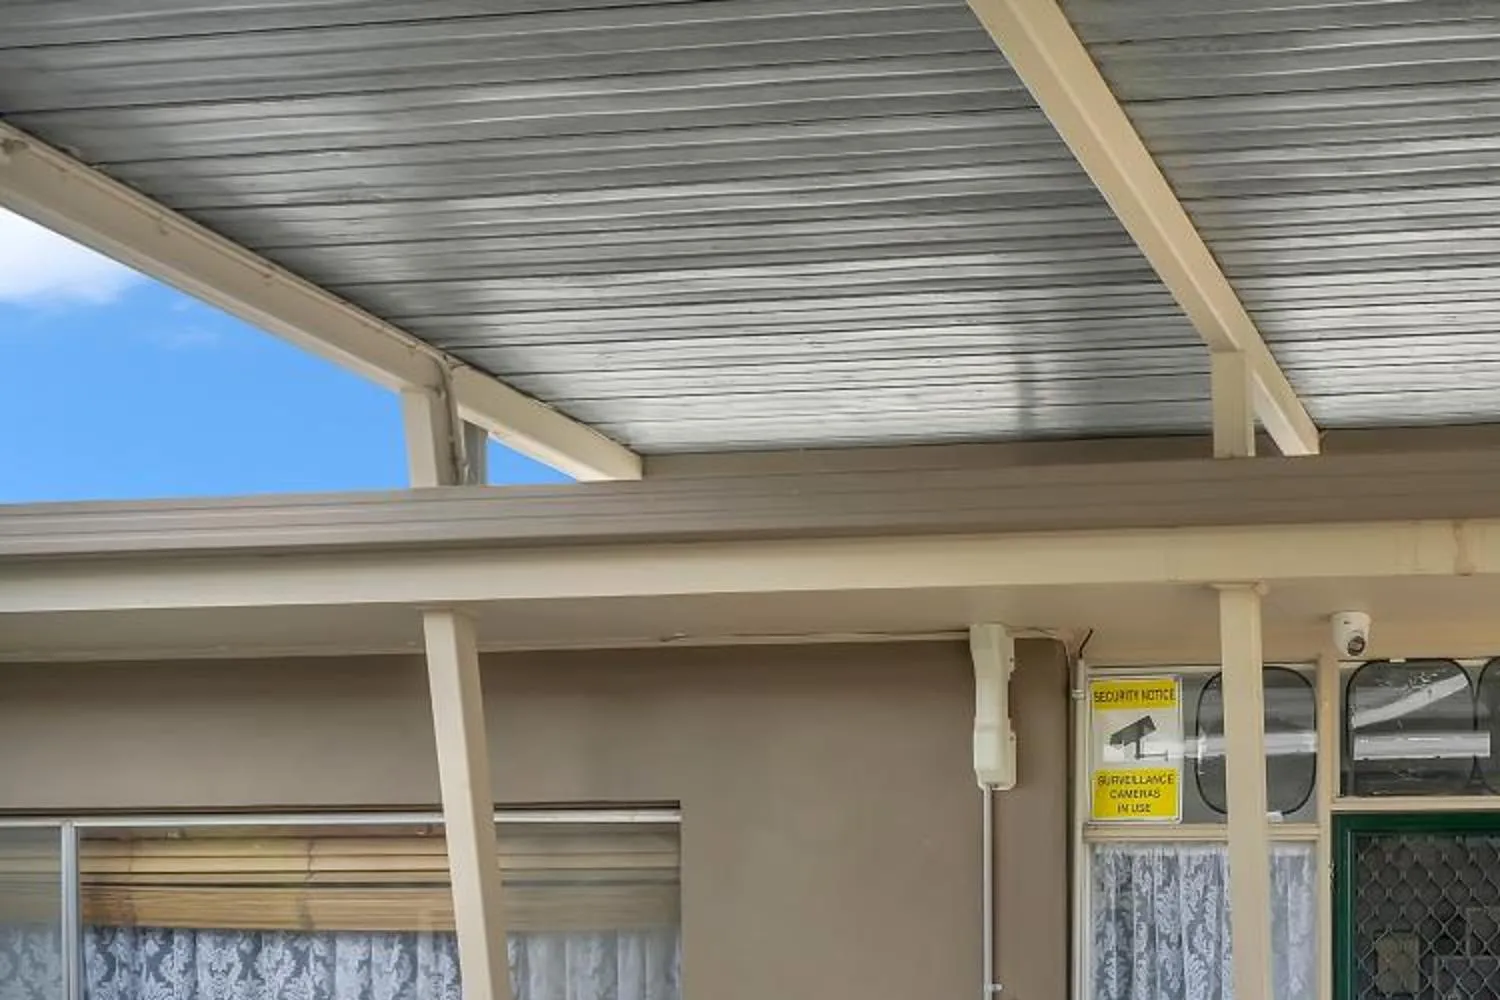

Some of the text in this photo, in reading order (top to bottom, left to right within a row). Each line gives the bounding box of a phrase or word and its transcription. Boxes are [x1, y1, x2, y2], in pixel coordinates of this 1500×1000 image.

[1094, 688, 1176, 702] SECURITY NOTICE
[1097, 774, 1174, 785] SURVEILLANCE
[1109, 788, 1161, 799] CAMERAS
[1117, 803, 1151, 813] IN USE
